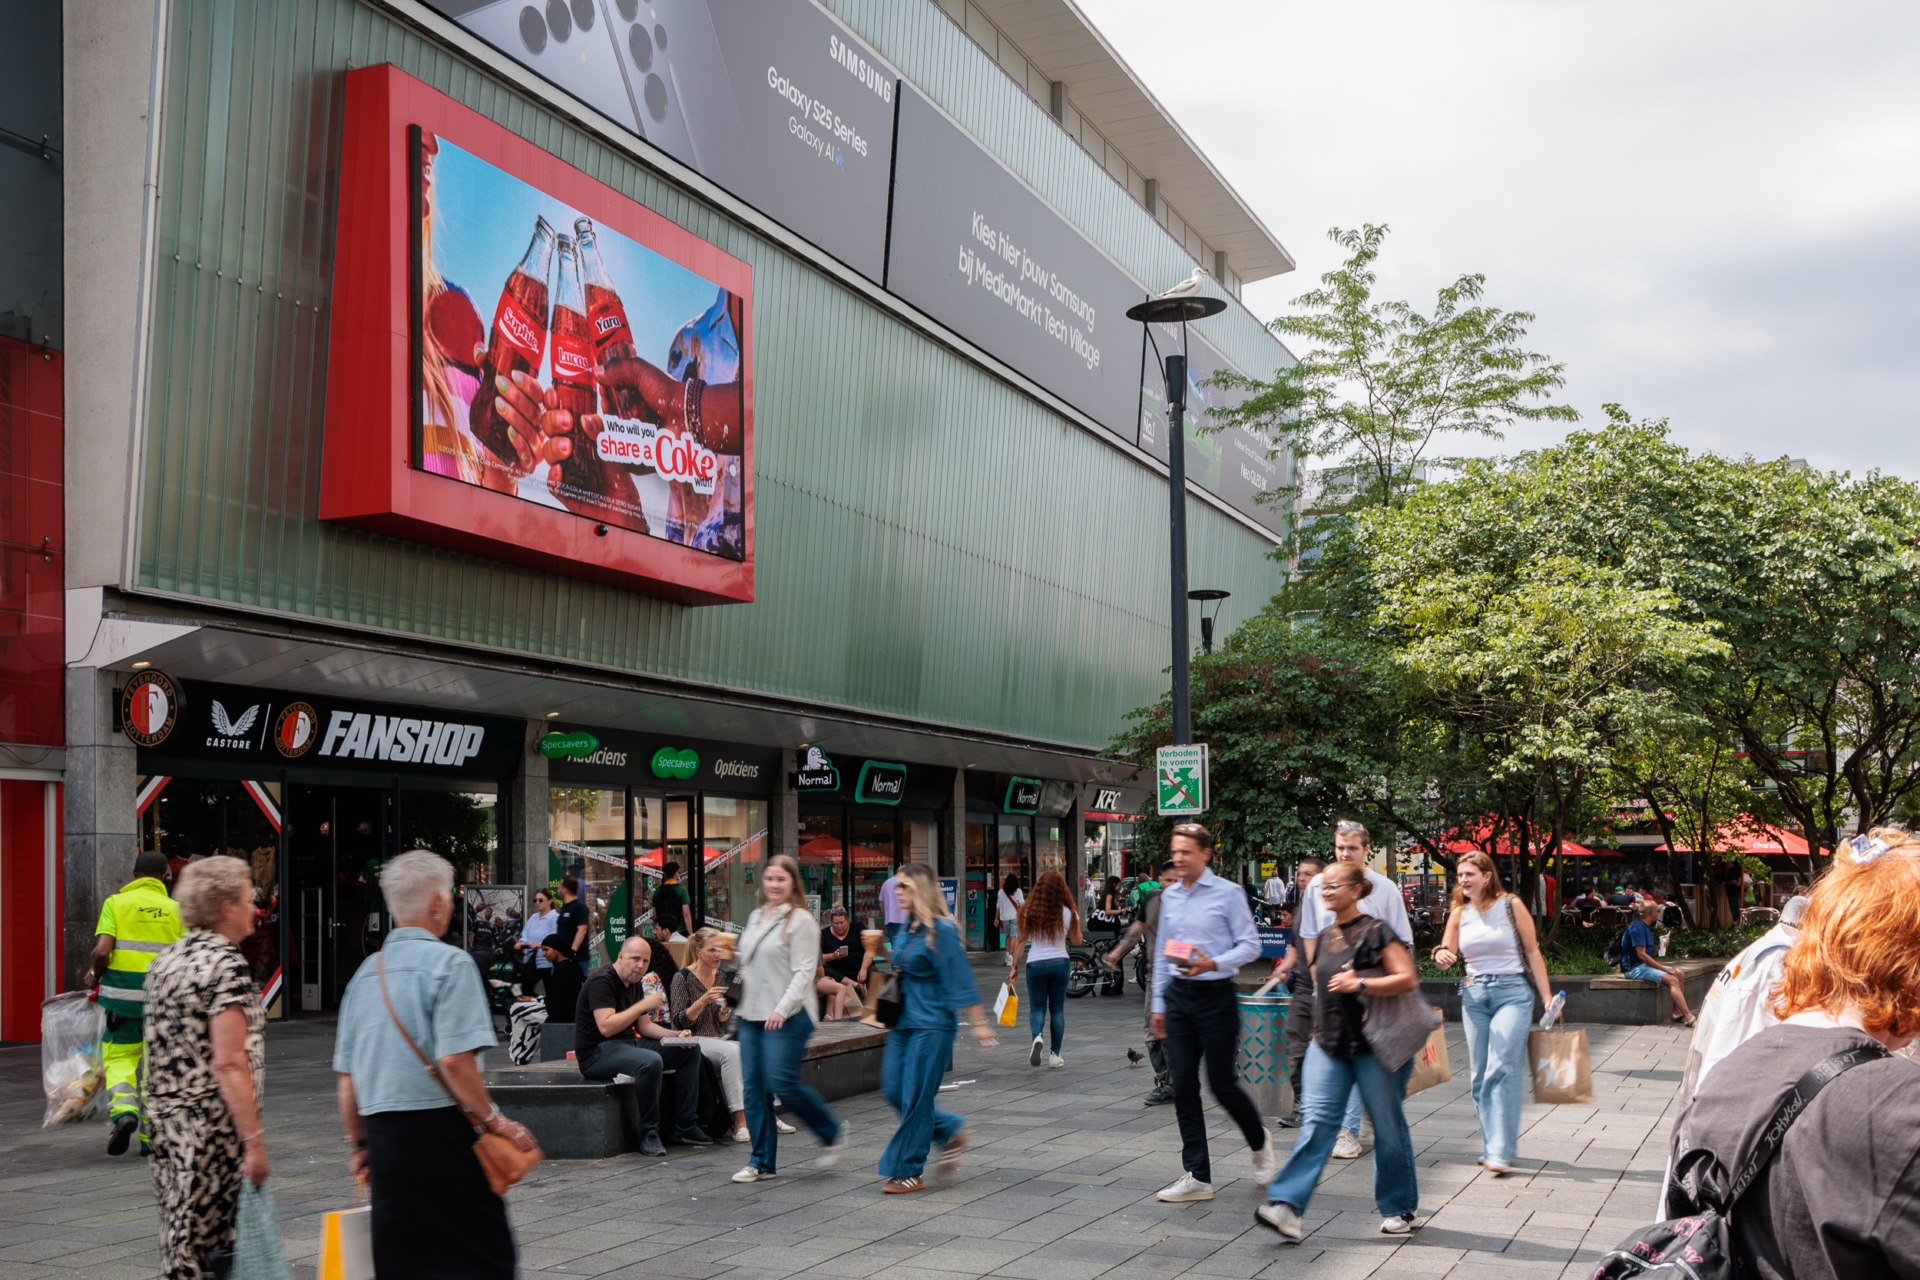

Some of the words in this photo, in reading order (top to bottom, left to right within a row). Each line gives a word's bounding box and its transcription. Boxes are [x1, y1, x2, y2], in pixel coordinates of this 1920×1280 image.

[830, 35, 891, 103] SAMSUNG
[767, 66, 812, 119] Galaxy
[812, 100, 833, 130] S25
[833, 116, 868, 157] Series
[788, 116, 824, 158] Galaxy
[824, 142, 835, 162] AI
[972, 211, 997, 251] Kies
[998, 231, 1021, 268] hier
[1020, 248, 1049, 290] jouw
[1050, 273, 1095, 333] Samsung
[958, 244, 974, 286] bij
[975, 257, 1042, 327] MediaMarkt
[1044, 307, 1068, 345] Tech
[1069, 326, 1100, 370] Village
[503, 307, 539, 349] Sophie
[595, 315, 621, 334] Yara
[558, 347, 589, 368] Lucas
[606, 421, 625, 434] Who
[626, 423, 640, 436] will
[640, 428, 655, 439] you
[600, 435, 640, 459] share
[643, 445, 653, 460] a
[655, 435, 714, 480] Coke
[694, 477, 713, 488] with?
[126, 674, 172, 700] FEYENOORD
[138, 691, 160, 727] F
[281, 704, 316, 724] FEYENOORD
[125, 716, 173, 743] ROTTERDAM
[318, 710, 485, 766] FANSHOP
[206, 737, 251, 749] CASTORE
[276, 737, 312, 757] ROTTERDAM
[542, 739, 589, 750] Specsavers
[657, 756, 697, 770] Specsavers
[1159, 749, 1199, 758] Verboden
[714, 758, 759, 779] Opticiens
[798, 773, 832, 786] Normal
[871, 774, 902, 793] Normal
[1017, 788, 1039, 804] Normal
[1094, 789, 1121, 811] KFC
[609, 916, 626, 925] Gratis
[611, 926, 626, 934] hoor-
[615, 934, 626, 942] test
